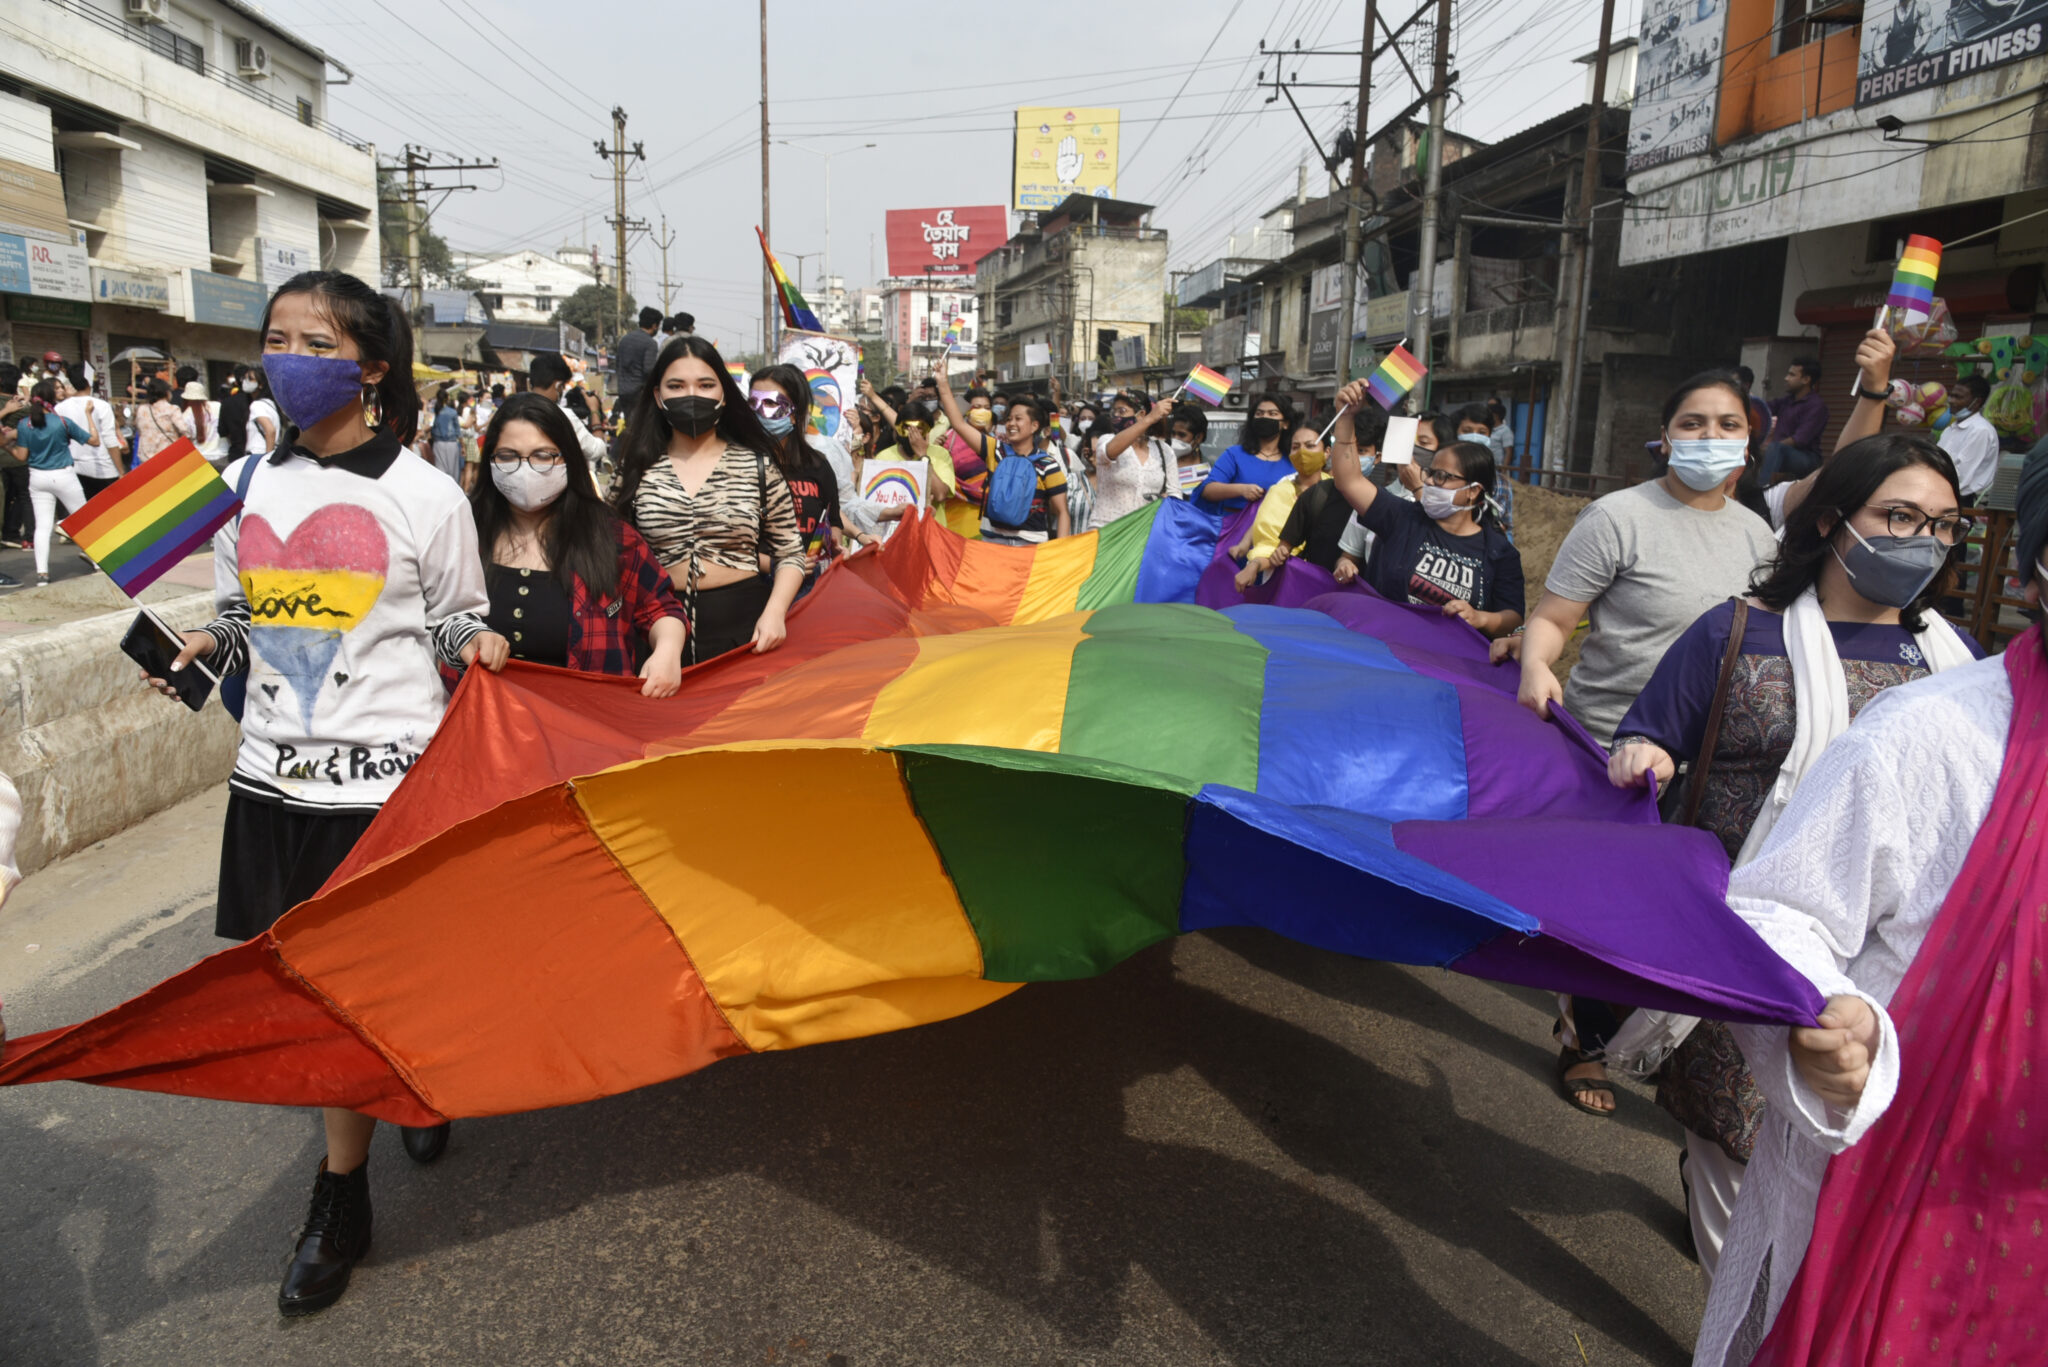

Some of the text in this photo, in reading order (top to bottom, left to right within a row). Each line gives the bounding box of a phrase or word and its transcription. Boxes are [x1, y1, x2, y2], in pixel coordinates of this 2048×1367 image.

[1859, 23, 2042, 102] PERFECT FITNESS
[1626, 134, 1708, 171] PERFECT FITNESS
[788, 480, 819, 498] RUN
[875, 490, 889, 503] You
[1415, 552, 1474, 589] GOOD
[350, 747, 421, 780] PROU
